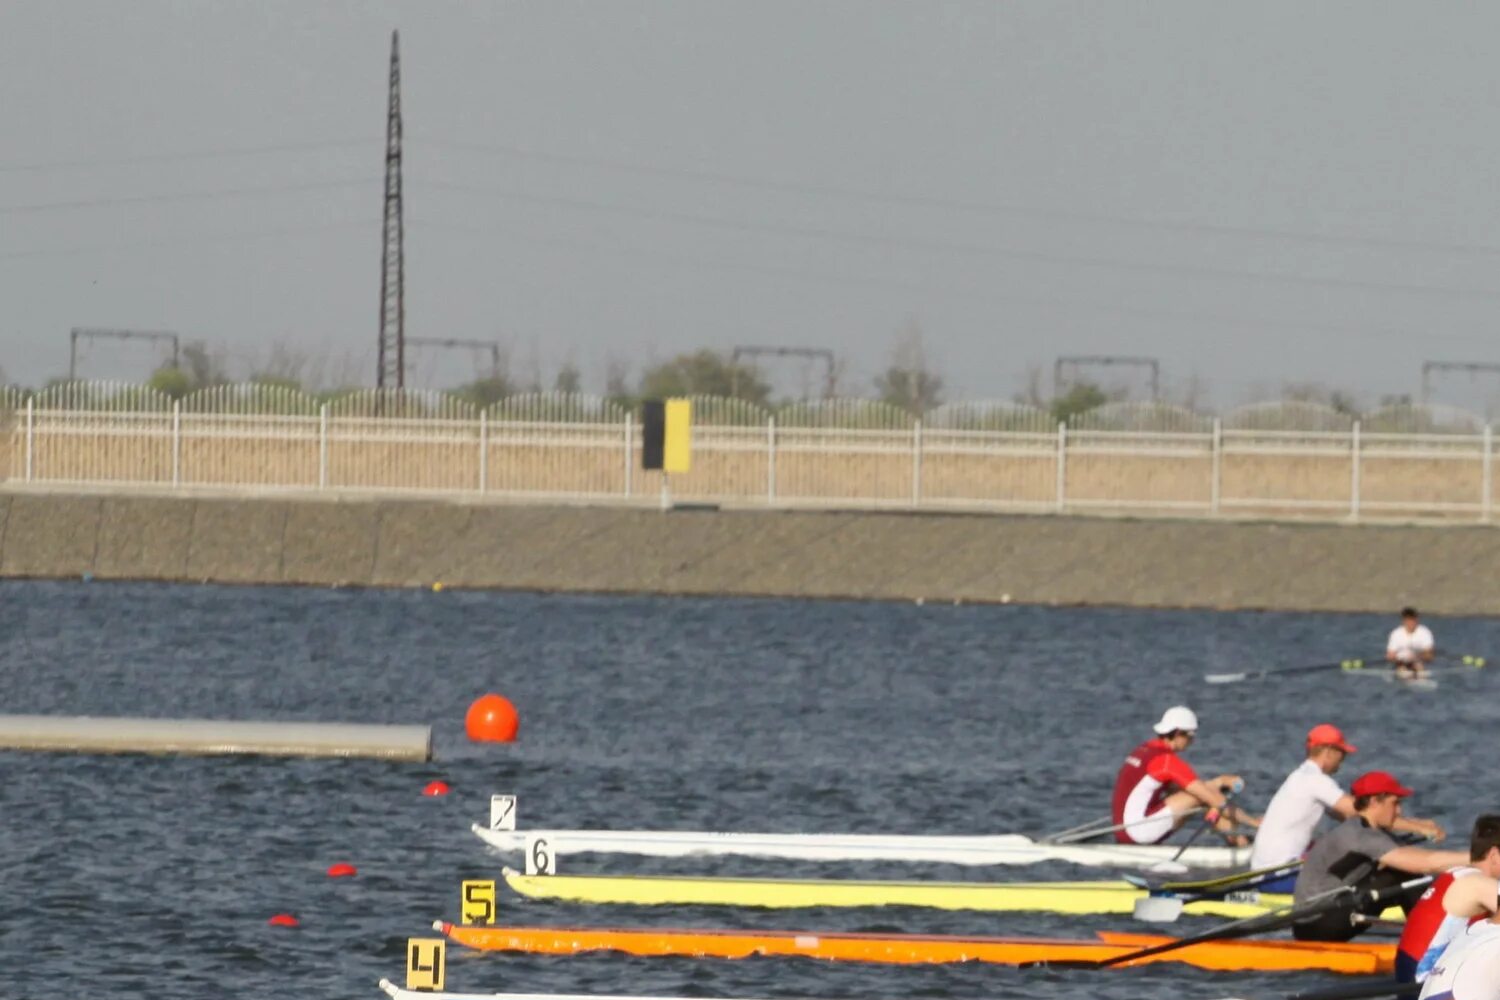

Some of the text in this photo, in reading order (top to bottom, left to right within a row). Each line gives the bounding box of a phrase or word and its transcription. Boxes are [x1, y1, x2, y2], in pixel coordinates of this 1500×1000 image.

[494, 796, 515, 827] 7
[533, 838, 548, 873] 6
[466, 885, 491, 920] 5
[412, 945, 440, 985] 4
